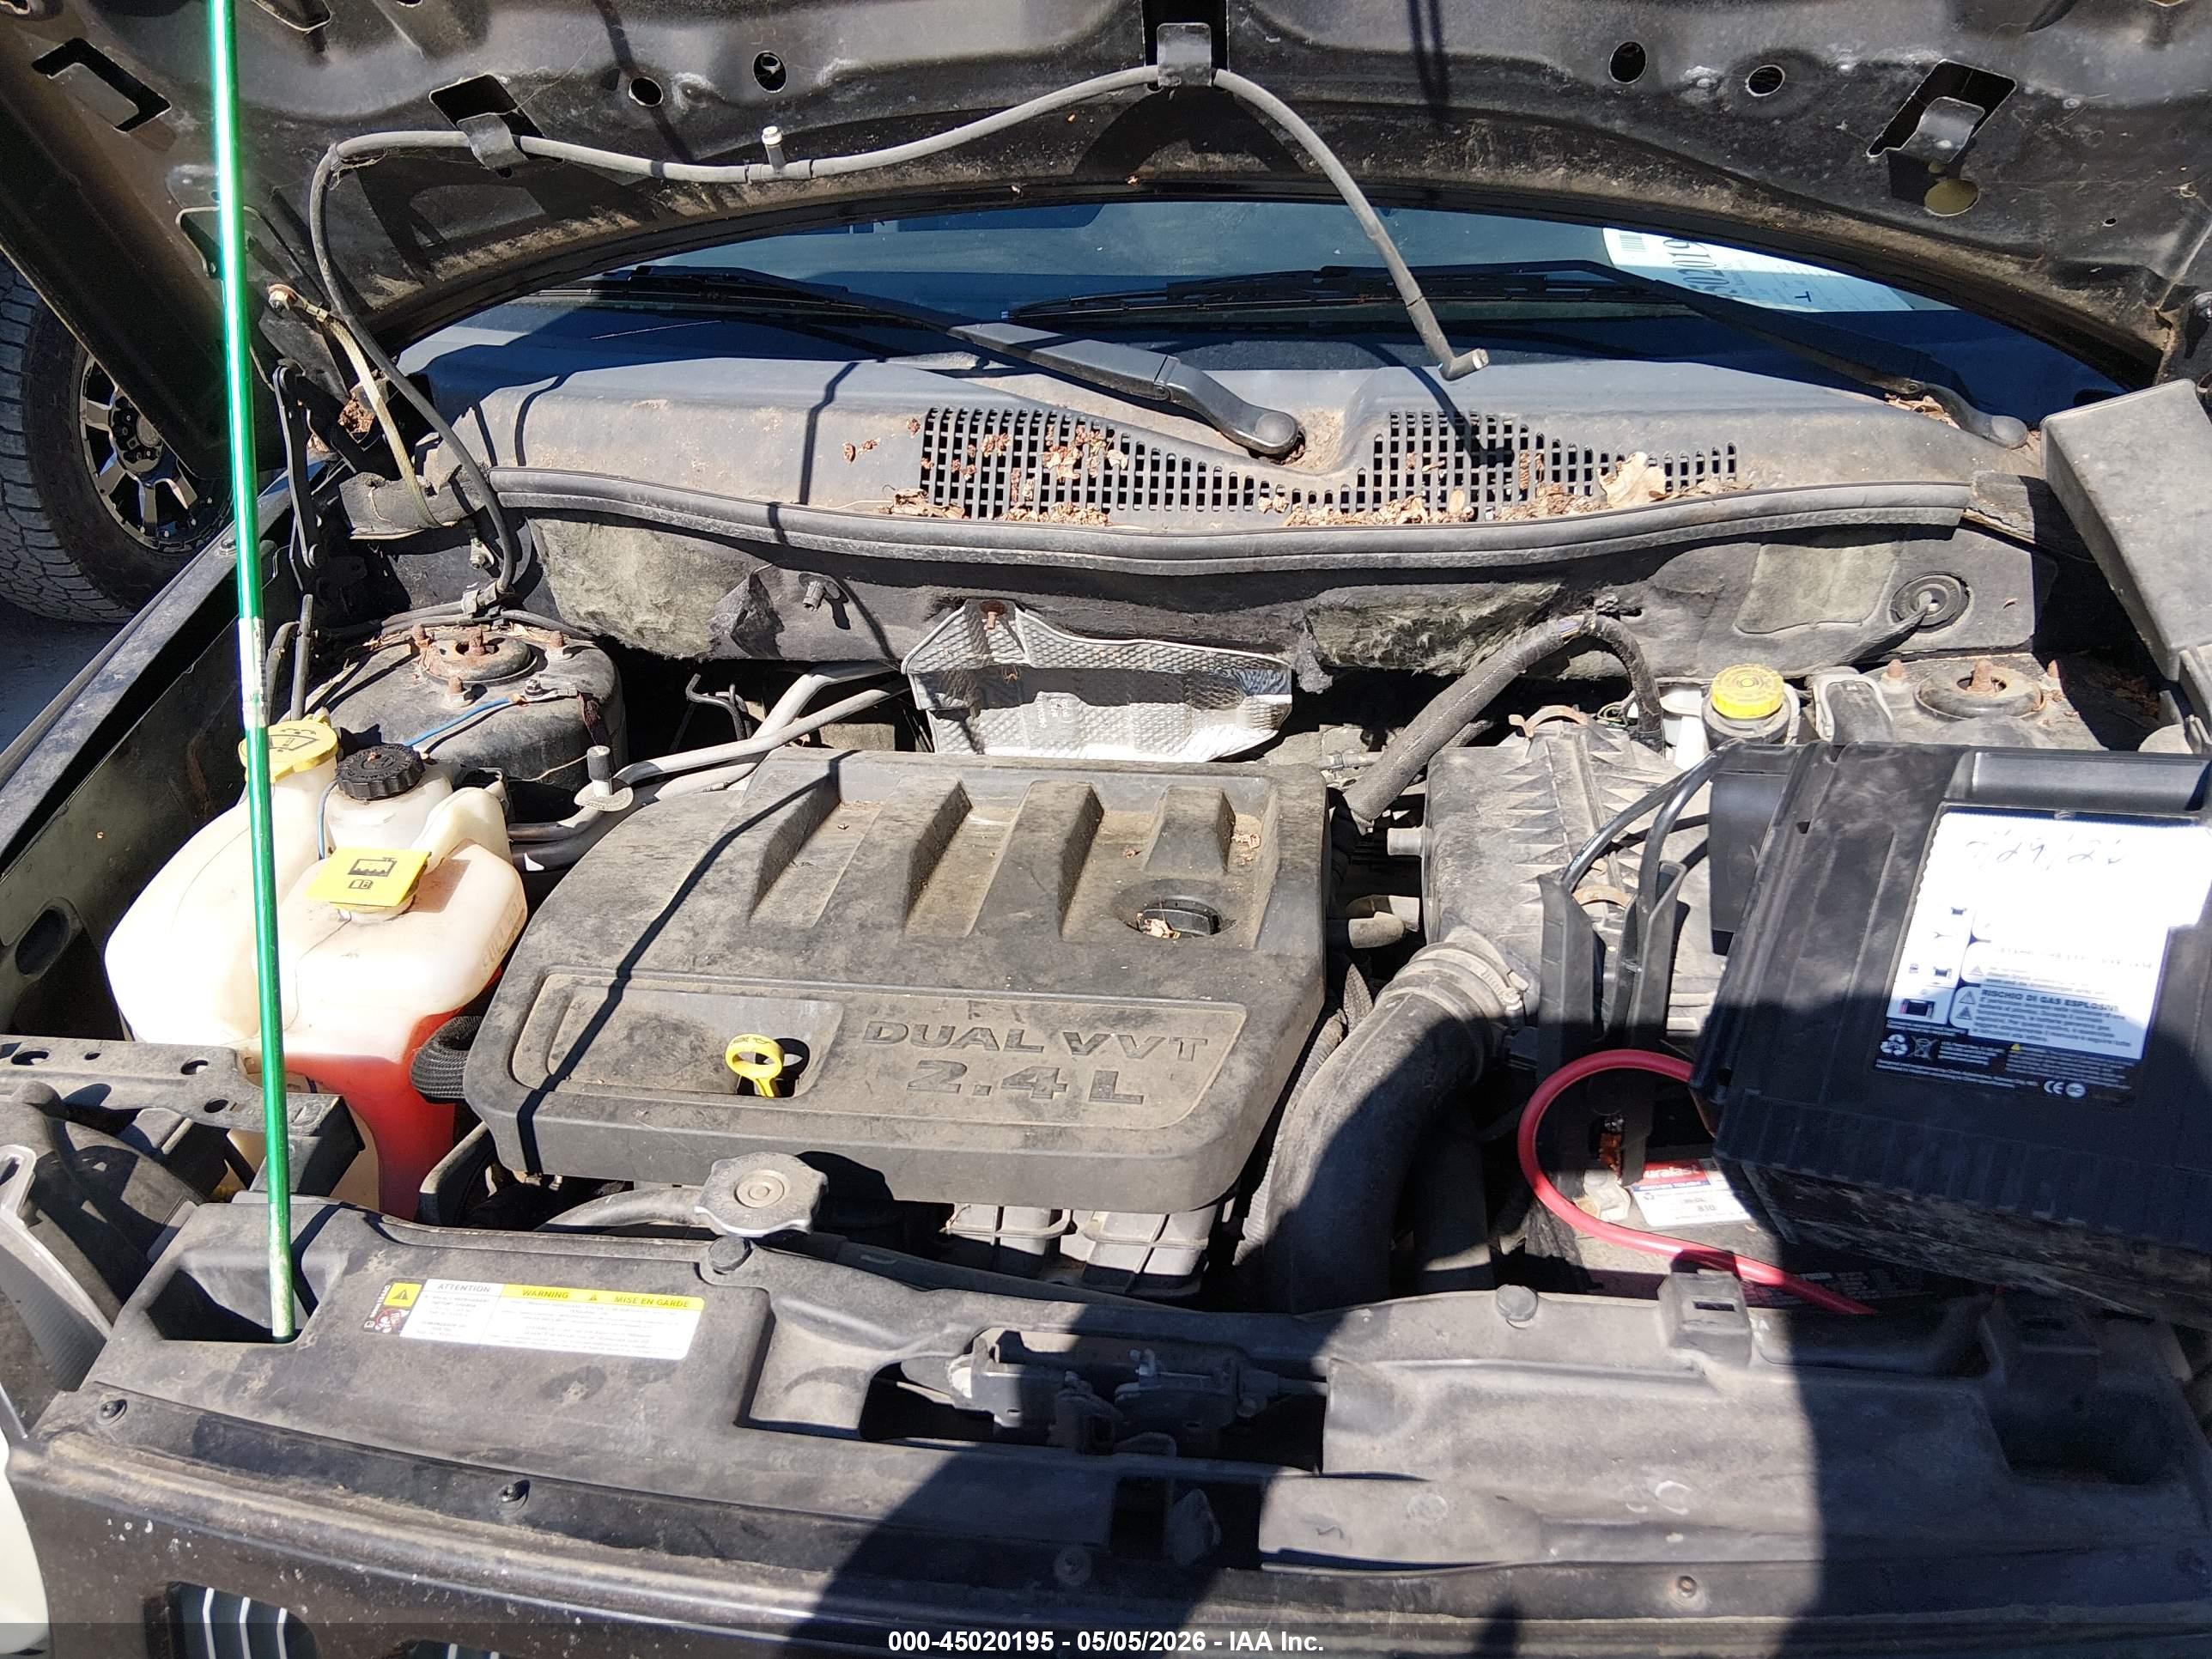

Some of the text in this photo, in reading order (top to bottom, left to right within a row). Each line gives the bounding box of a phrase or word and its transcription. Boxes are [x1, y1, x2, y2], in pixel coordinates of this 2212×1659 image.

[1981, 988, 2023, 1001] RISCHIO
[2026, 994, 2038, 1002] DI
[2039, 996, 2062, 1006] GAS
[863, 1019, 1208, 1062] DUAL VVT
[907, 1060, 1145, 1105] 2.4L
[1643, 1164, 1701, 1179] uralast
[437, 1283, 490, 1293] ATTENTION
[522, 1289, 570, 1299] WARNING
[614, 1296, 640, 1304] MISE
[656, 1298, 690, 1309] GARDE
